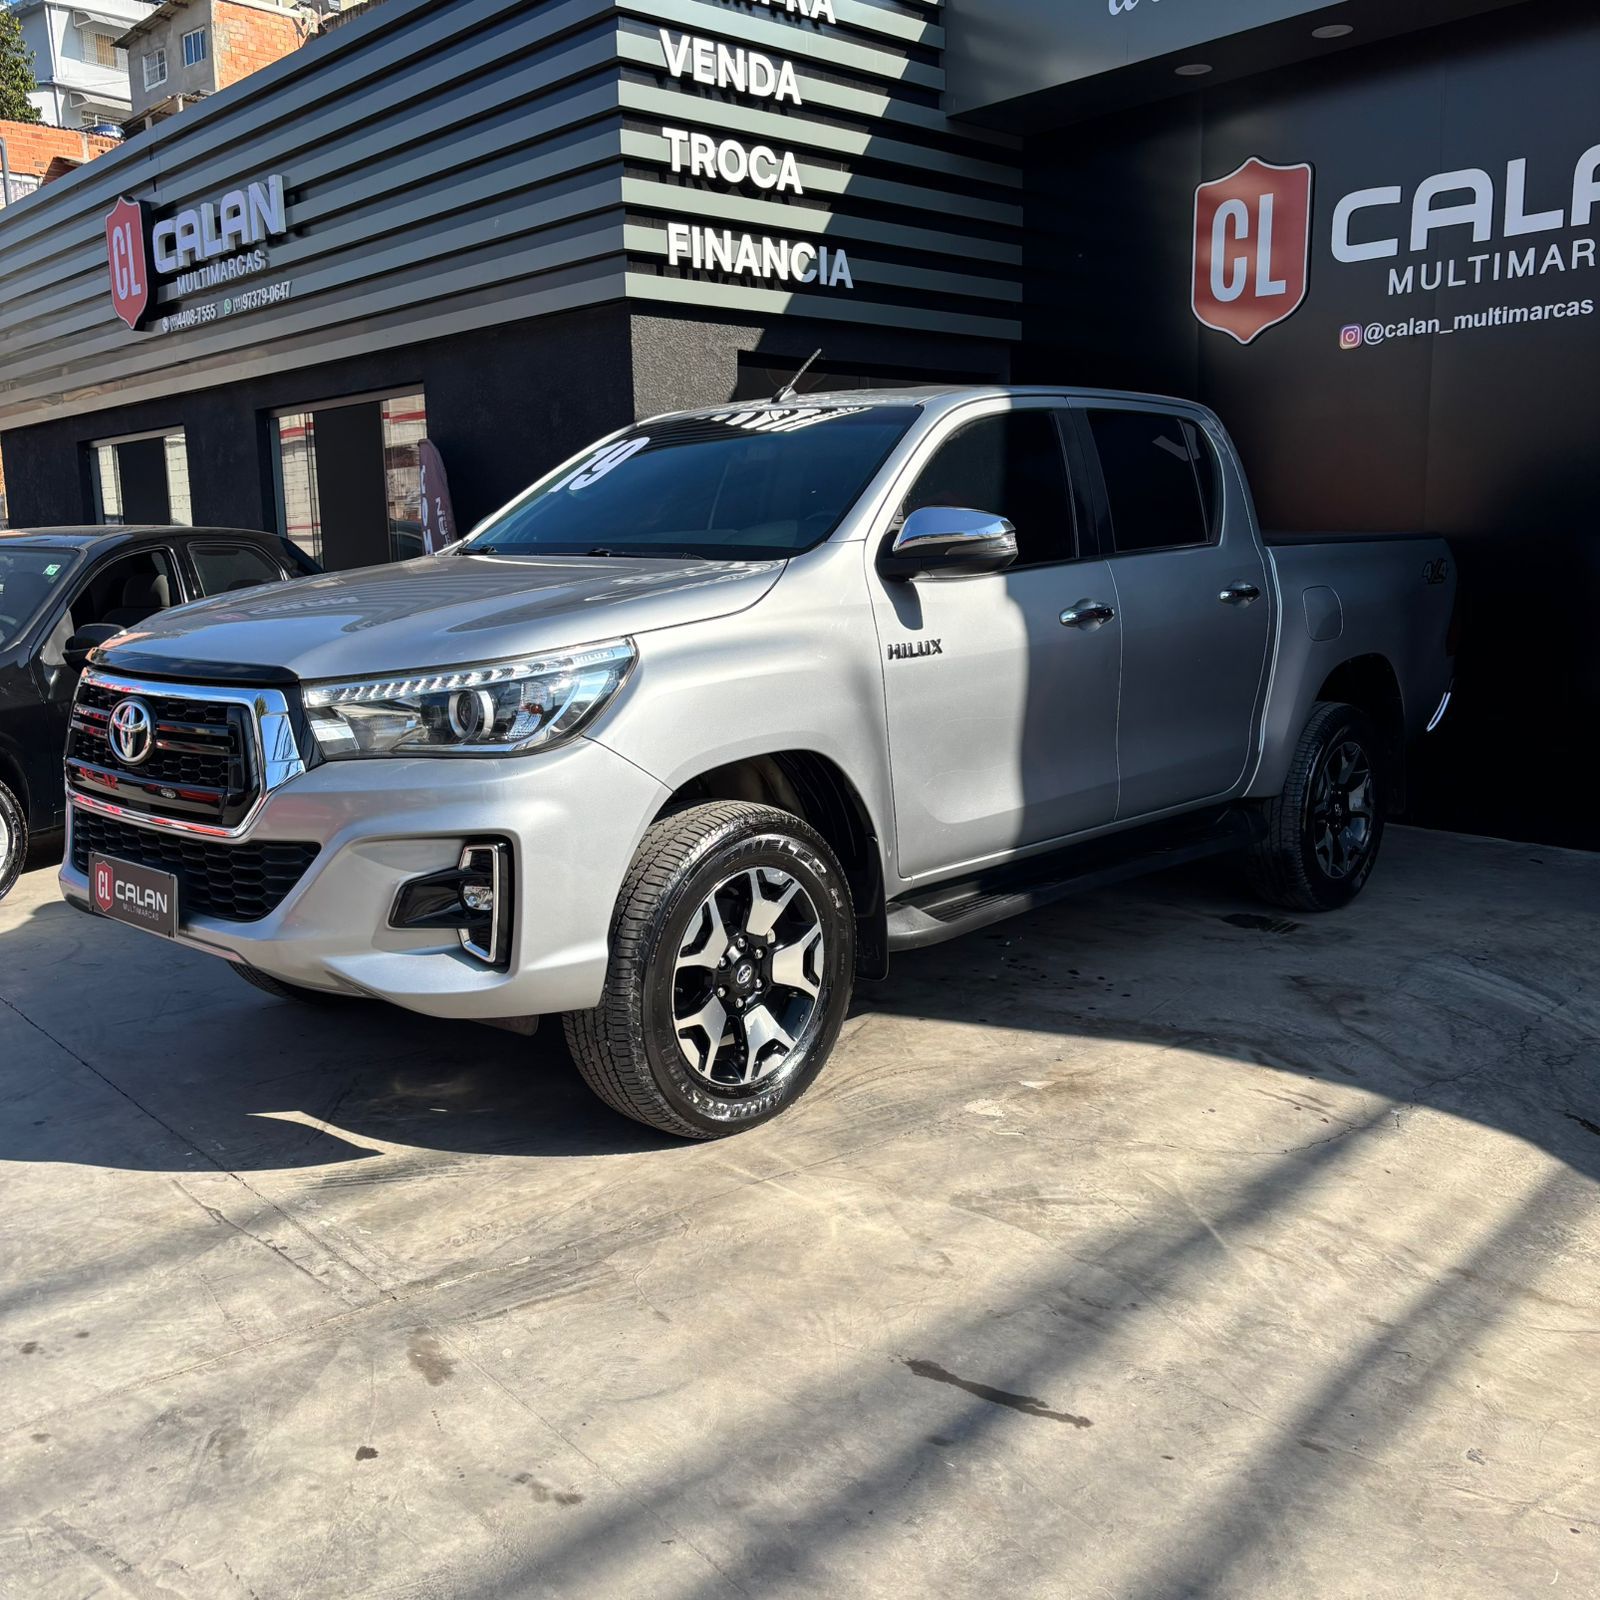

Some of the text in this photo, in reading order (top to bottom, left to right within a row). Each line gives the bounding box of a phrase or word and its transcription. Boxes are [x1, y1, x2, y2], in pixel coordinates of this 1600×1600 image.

[659, 28, 803, 105] VENDA
[661, 127, 804, 195] TROCA
[153, 174, 286, 274] CALAN
[1210, 192, 1287, 302] CL
[113, 222, 142, 300] CL
[176, 250, 266, 296] MULTIMARCAS
[667, 222, 854, 290] FINANCIA
[1387, 238, 1597, 296] MULTIMAR
[1363, 298, 1595, 346] @calan_multimarcas
[549, 436, 650, 492] 19
[887, 638, 943, 660] HILUX
[97, 870, 110, 900] CL
[115, 880, 168, 914] CALAN
[122, 902, 160, 920] MULTIMARCAS
